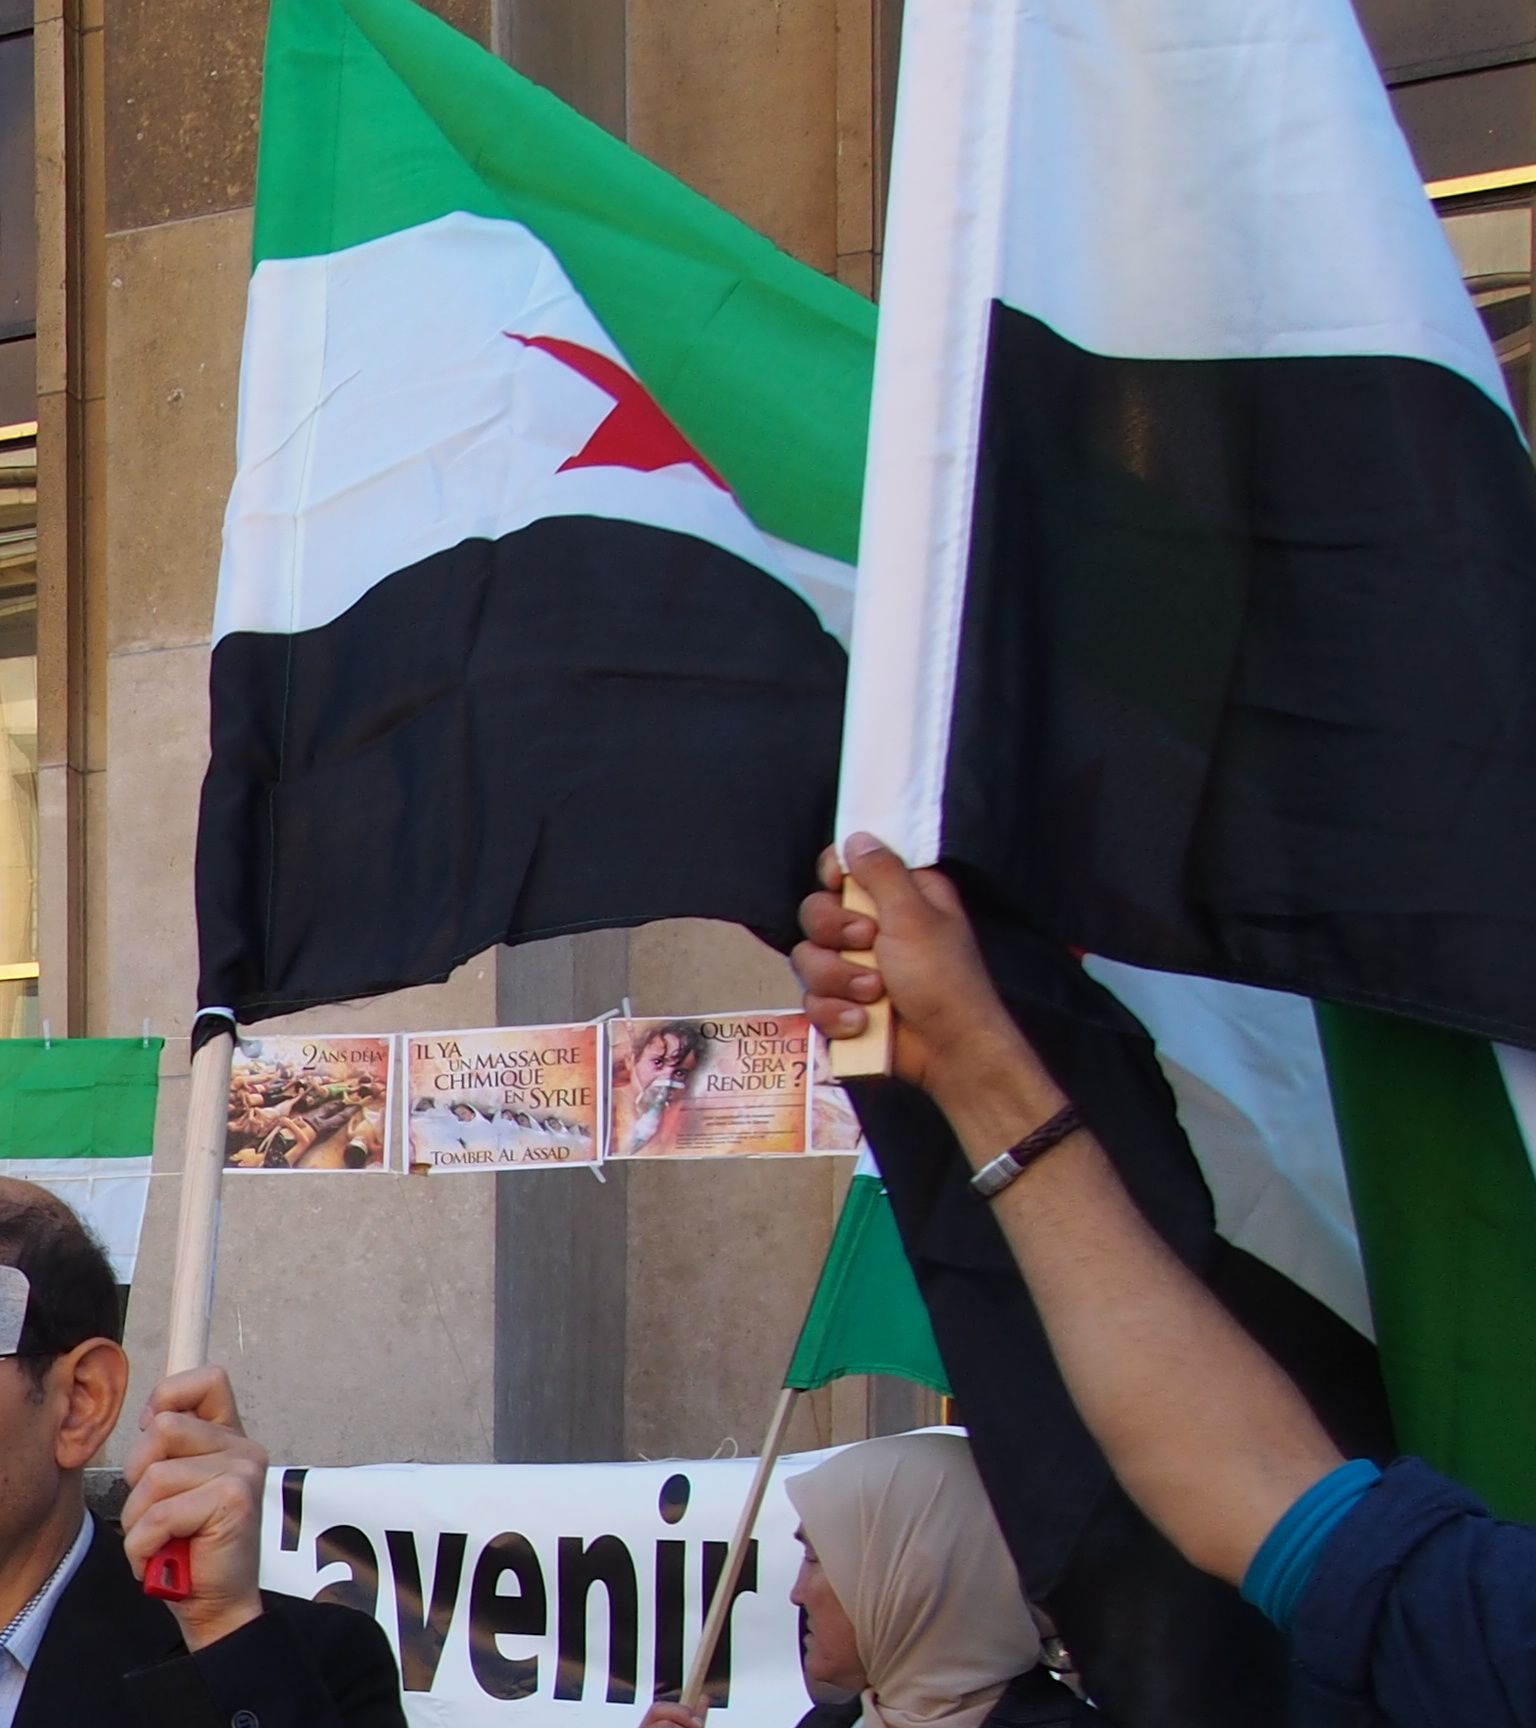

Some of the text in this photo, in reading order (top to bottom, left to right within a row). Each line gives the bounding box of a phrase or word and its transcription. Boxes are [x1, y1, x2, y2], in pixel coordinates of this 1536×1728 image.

[700, 1021, 778, 1042] QUAND
[302, 1044, 317, 1070] 2
[319, 1050, 348, 1063] ANS
[416, 1044, 434, 1060] IL
[449, 1047, 581, 1071] UN MASSACRE
[737, 1038, 808, 1060] JUSTICE
[741, 1057, 785, 1074] SERA
[434, 1068, 544, 1090] CHIMIQUE
[707, 1074, 786, 1092] RENDUE
[504, 1087, 591, 1109] EN SYRIE
[431, 1146, 570, 1166] TOMBER AL ASSAD
[280, 1469, 759, 1709] 'avenir
